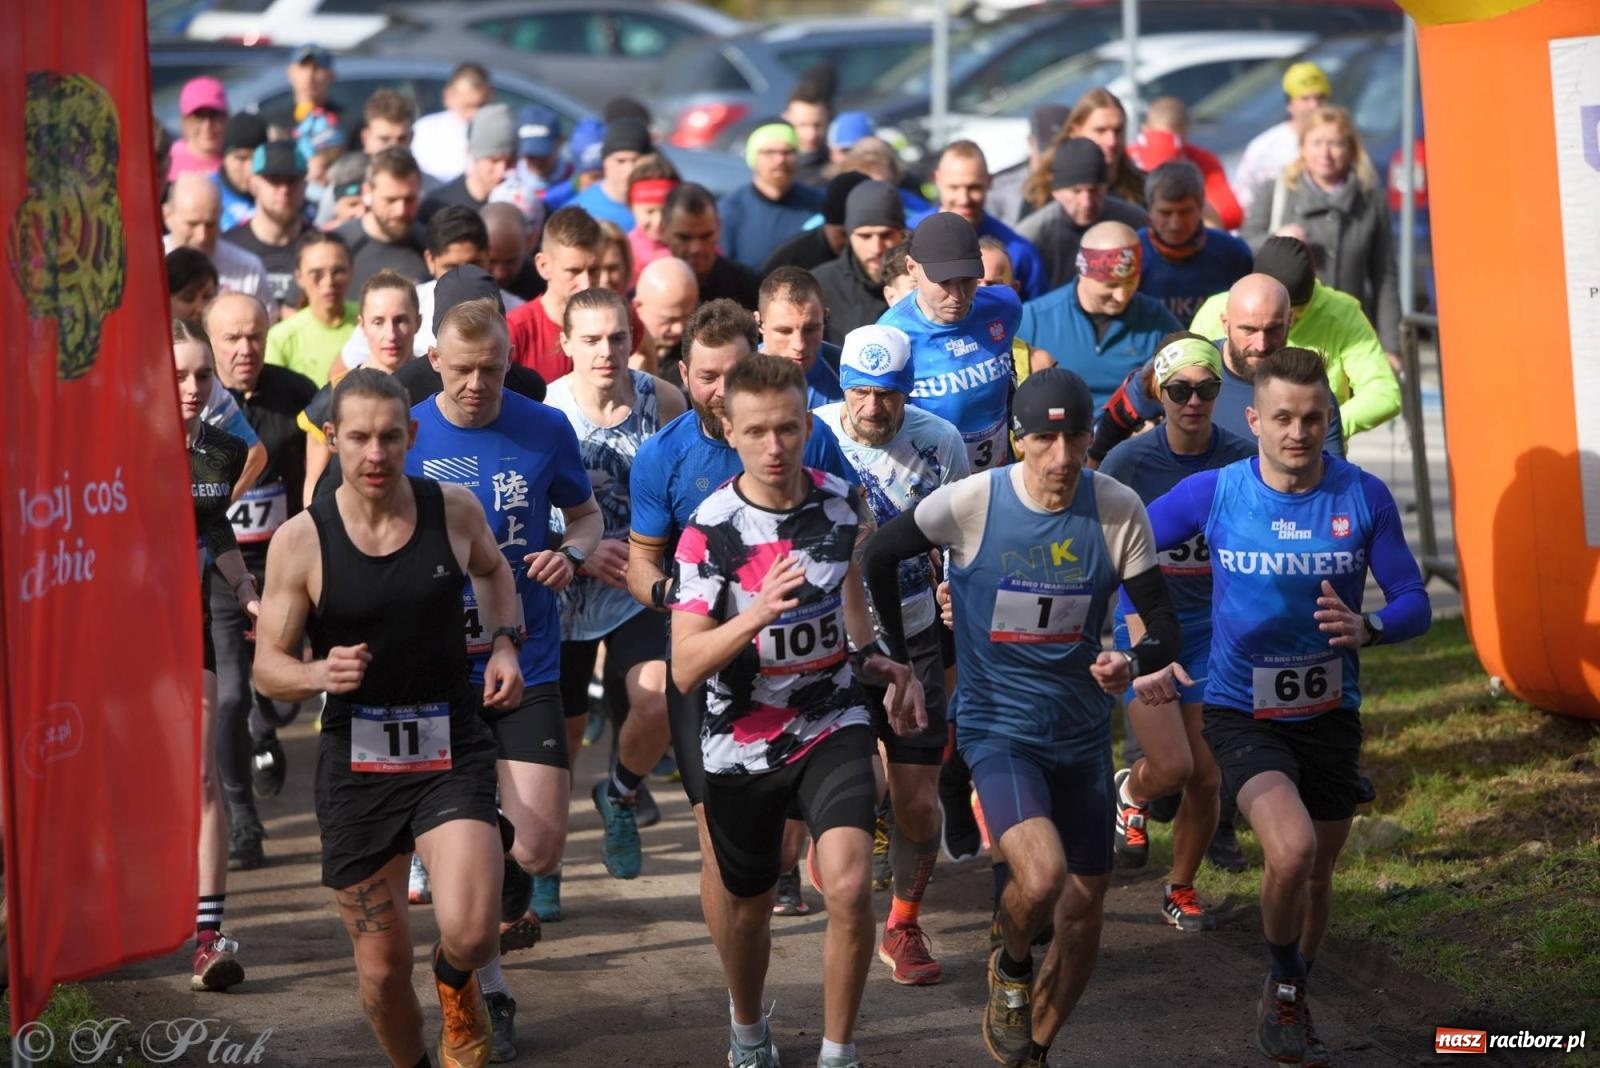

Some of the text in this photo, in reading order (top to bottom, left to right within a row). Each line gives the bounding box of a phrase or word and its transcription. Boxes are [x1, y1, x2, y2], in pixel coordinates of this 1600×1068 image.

[83, 466, 128, 515] coś
[230, 500, 273, 528] 47
[491, 470, 530, 550] 陸上
[1218, 548, 1365, 575] RUNNERS
[1036, 597, 1054, 628] 1
[769, 612, 839, 661] 105
[1275, 666, 1328, 702] 66
[383, 721, 420, 757] 11
